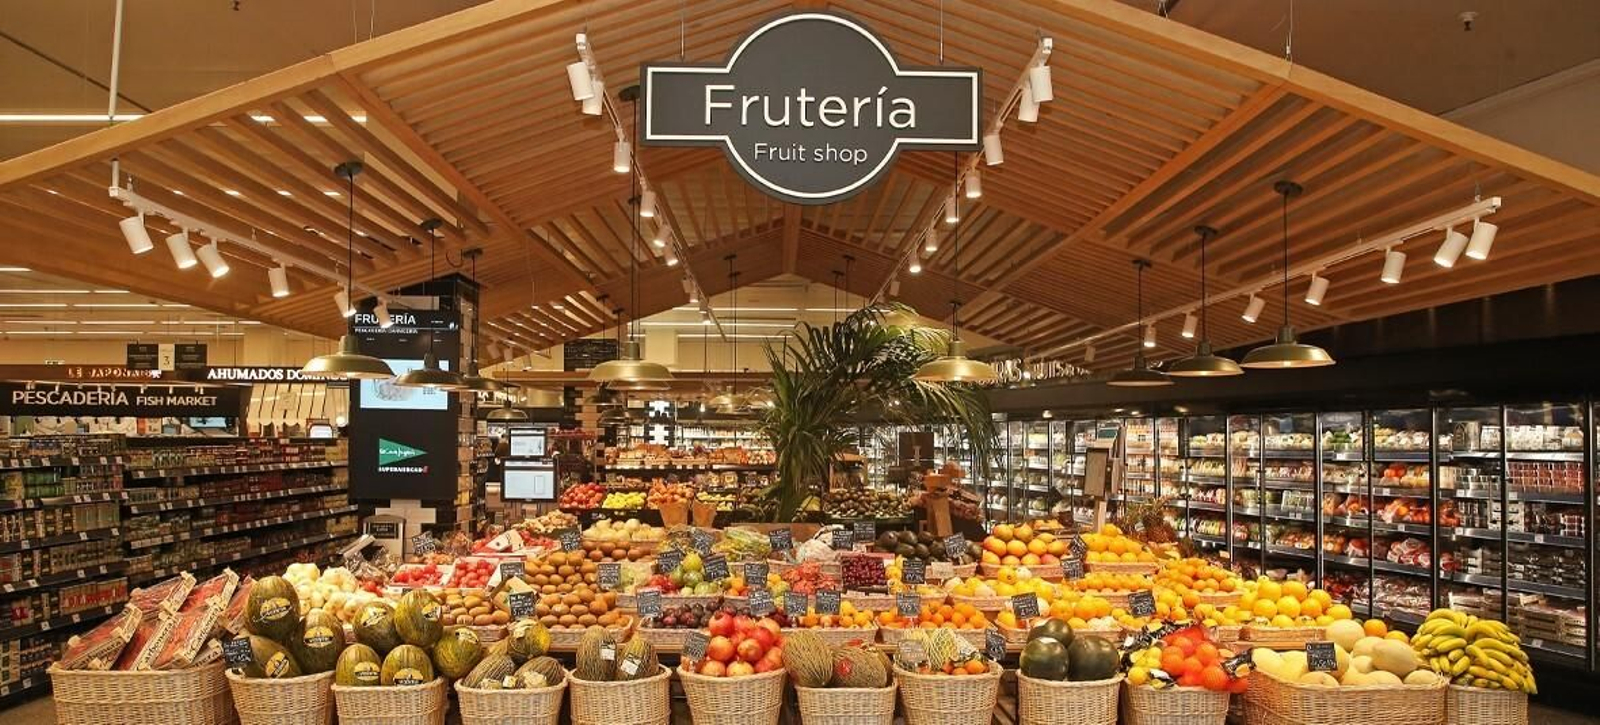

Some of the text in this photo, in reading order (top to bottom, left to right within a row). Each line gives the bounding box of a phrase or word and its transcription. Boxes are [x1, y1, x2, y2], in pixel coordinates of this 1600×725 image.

[704, 84, 916, 128] Frutería
[753, 143, 868, 165] Fruit shop
[354, 312, 416, 325] FRUERÍA
[207, 368, 284, 380] AHUMADOS
[136, 396, 164, 406] FISH
[166, 396, 218, 406] MARKET
